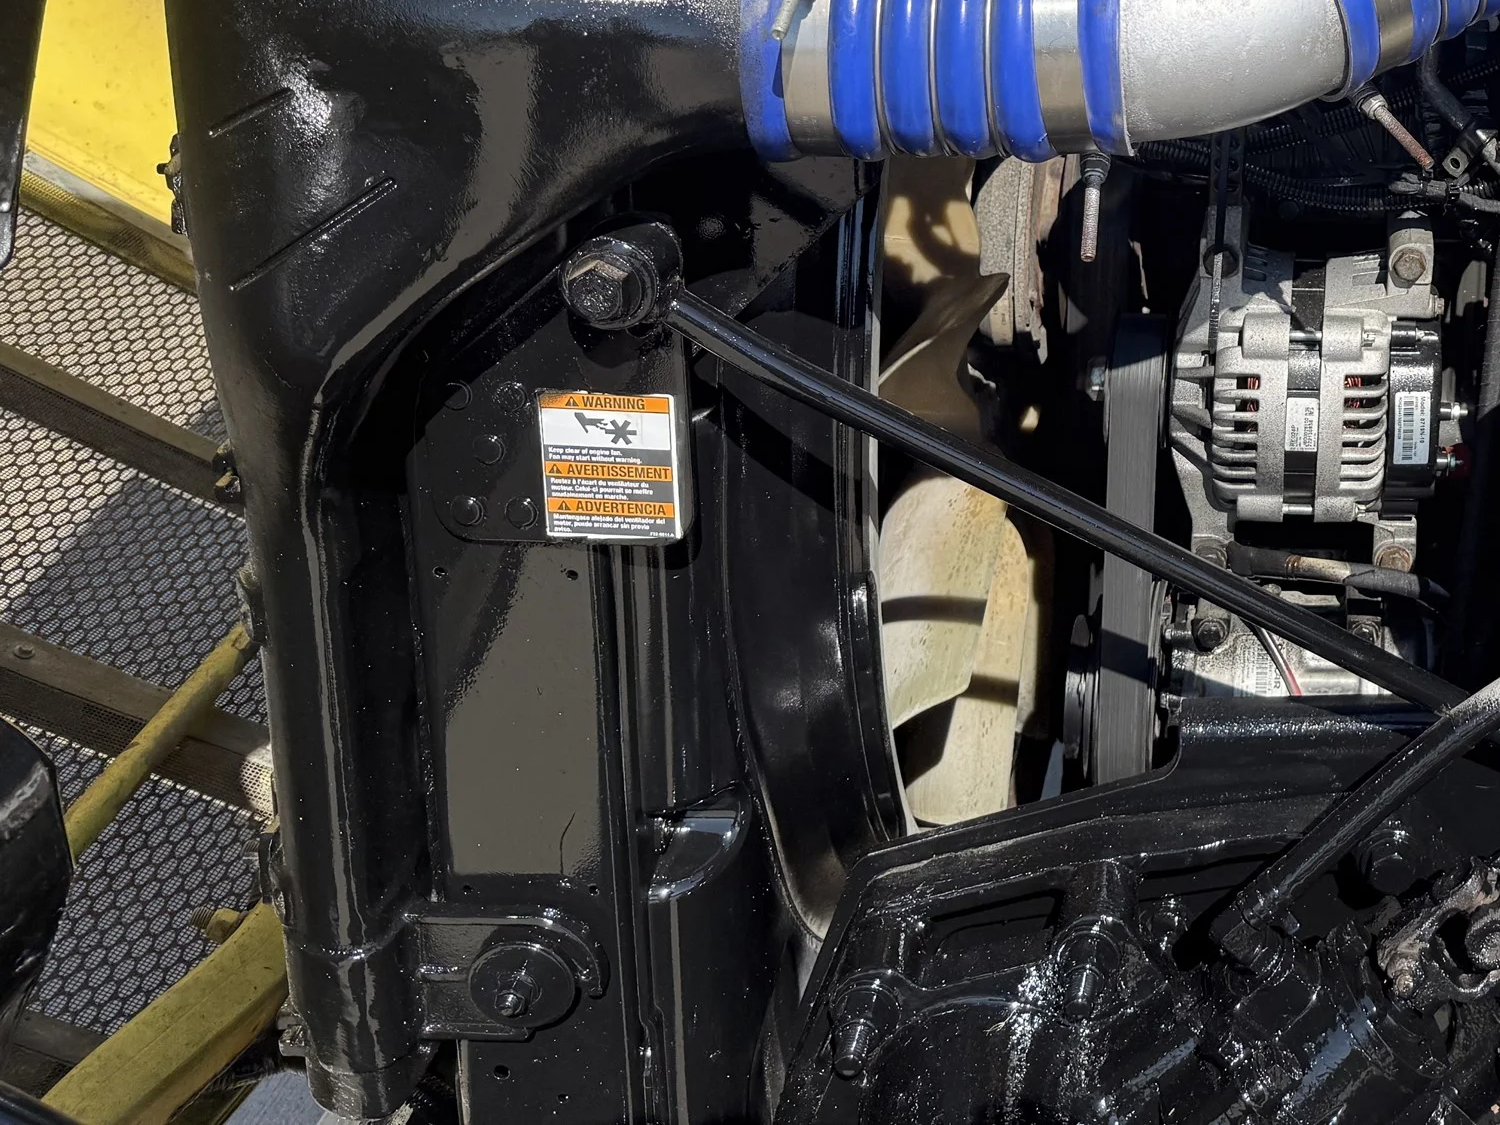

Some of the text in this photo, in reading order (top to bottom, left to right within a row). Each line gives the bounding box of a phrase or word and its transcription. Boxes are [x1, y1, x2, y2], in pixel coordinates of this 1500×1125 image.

[582, 396, 645, 409] WARNING
[567, 465, 669, 479] AVERTISSEMENT
[576, 501, 666, 515] ADVERTENCIA
